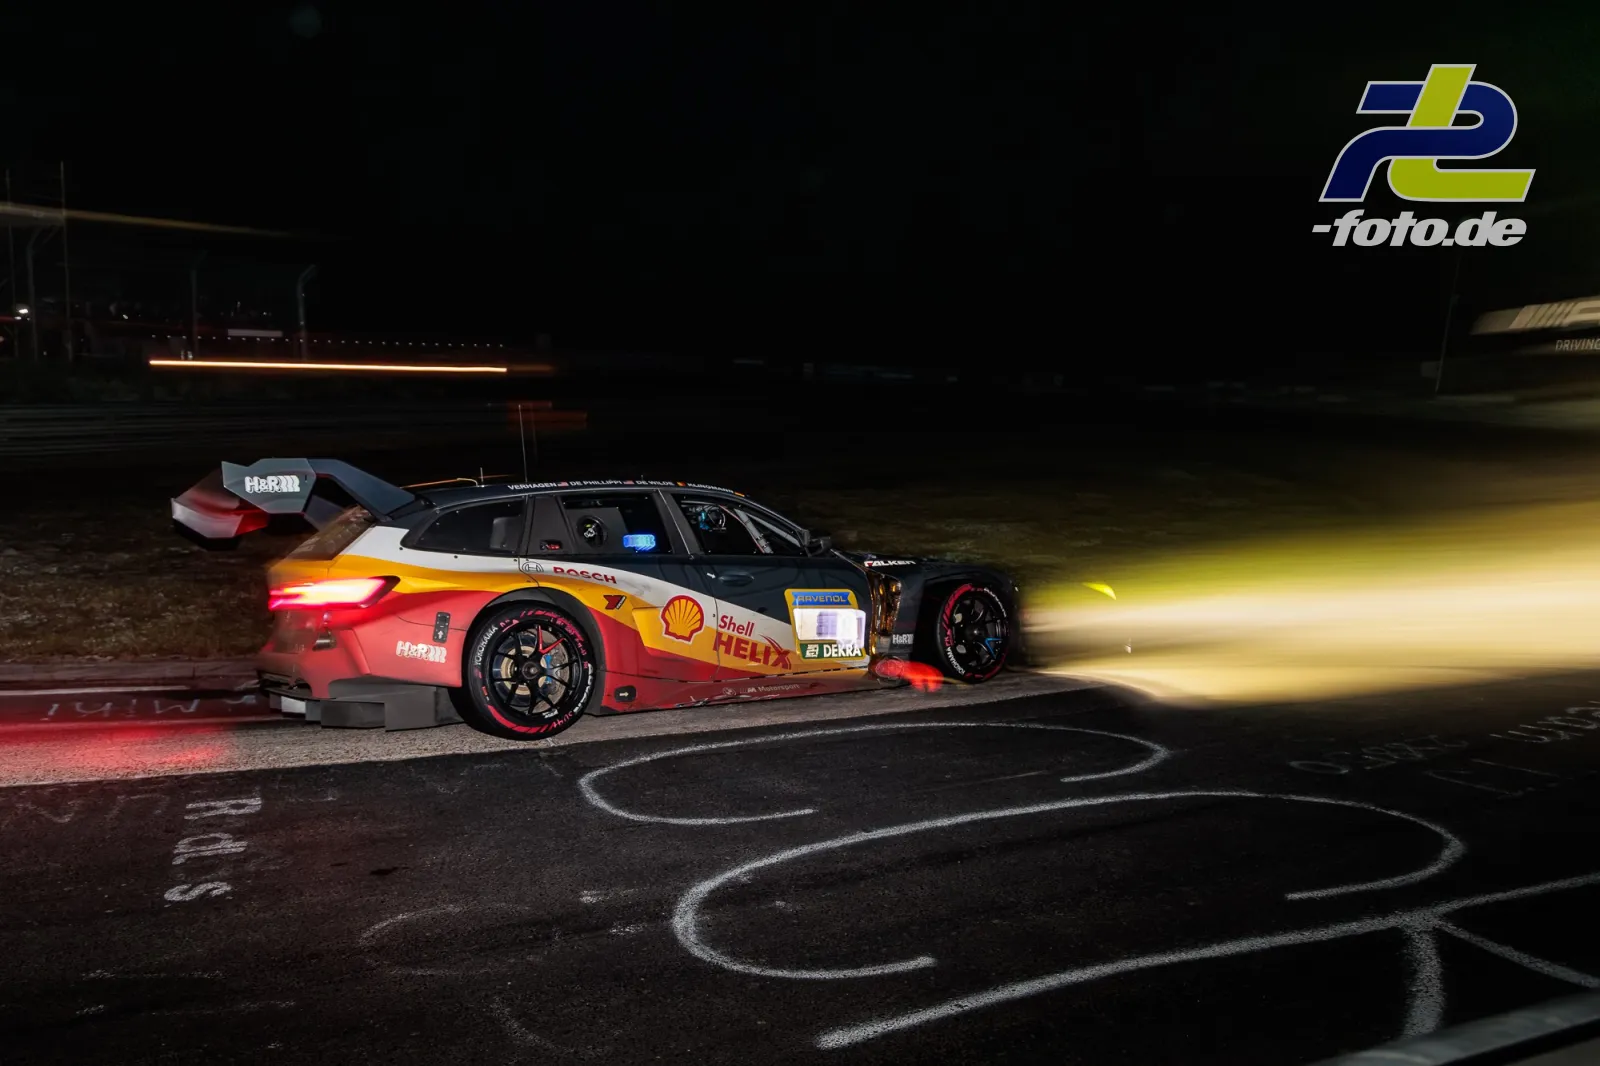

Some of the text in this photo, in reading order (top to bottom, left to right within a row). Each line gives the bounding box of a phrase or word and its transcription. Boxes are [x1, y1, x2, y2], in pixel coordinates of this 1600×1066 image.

[553, 566, 618, 584] BOSCH
[718, 614, 755, 637] Shell
[473, 625, 498, 666] YOKOHAMA
[712, 631, 792, 670] HELIX
[823, 644, 861, 658] DEKRA
[758, 683, 800, 693] Motorsport
